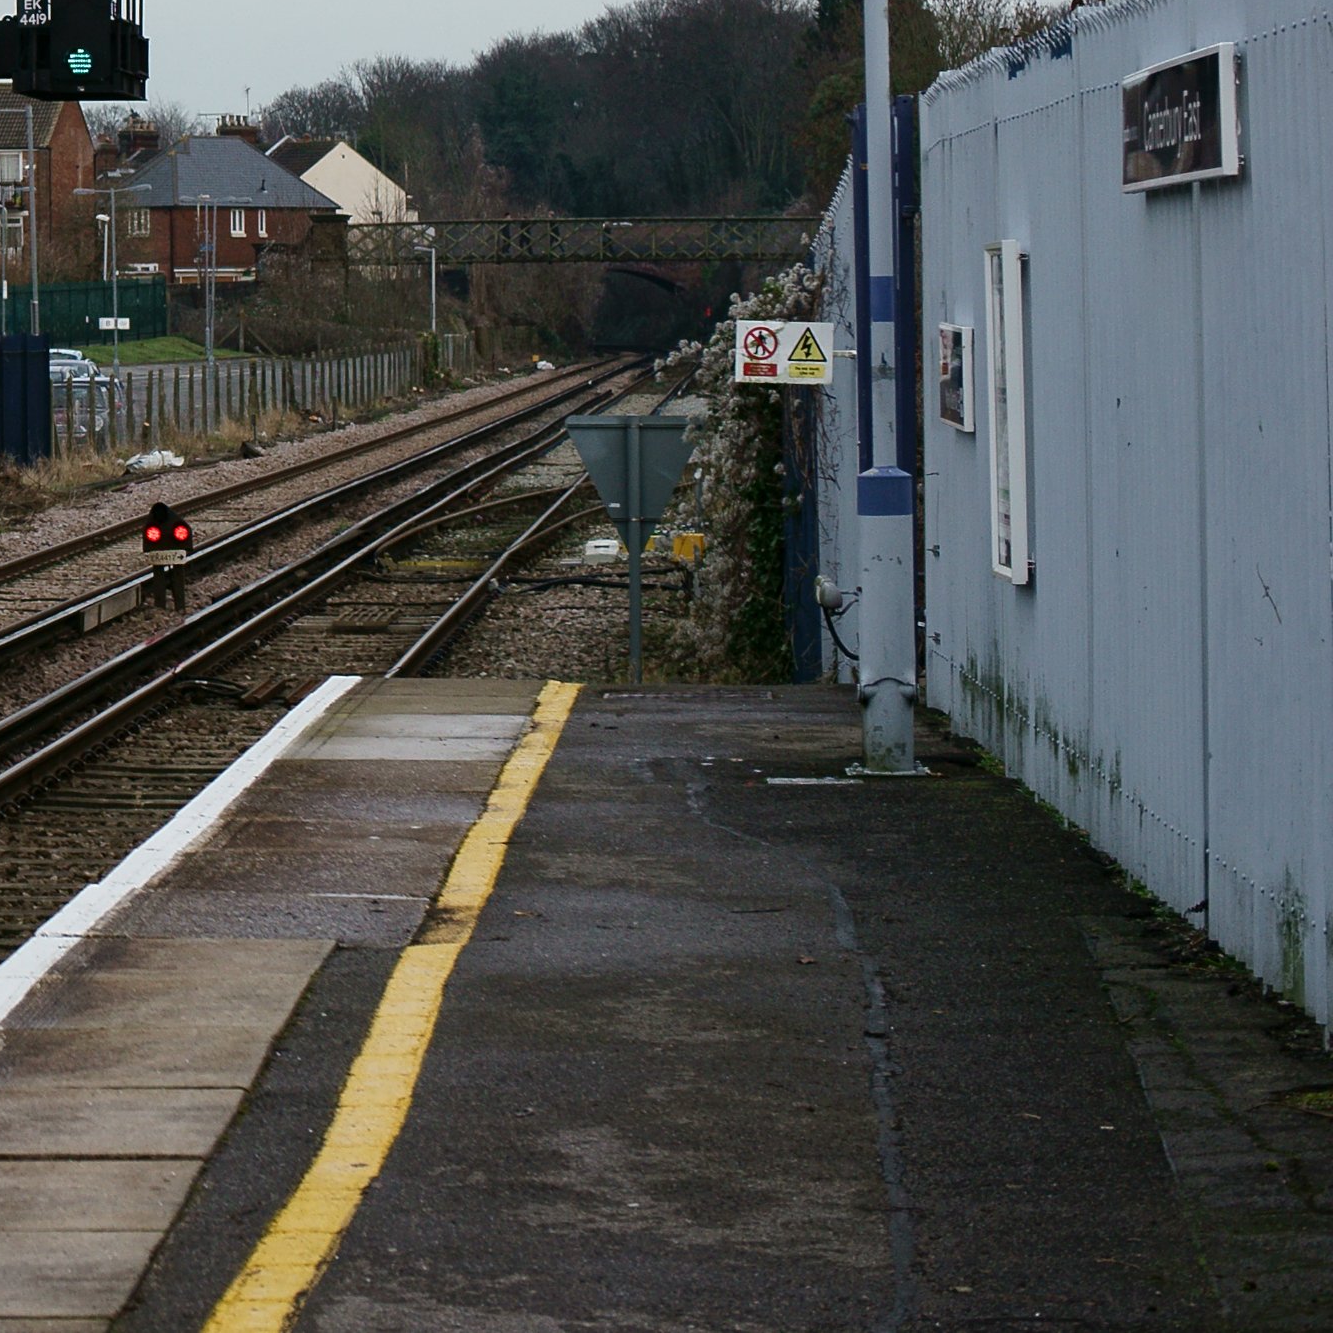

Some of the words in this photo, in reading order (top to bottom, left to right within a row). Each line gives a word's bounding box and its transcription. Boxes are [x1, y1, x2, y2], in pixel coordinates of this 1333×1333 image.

[19, 13, 47, 26] 4419
[1143, 97, 1183, 158] Canterbury
[1183, 90, 1201, 142] East
